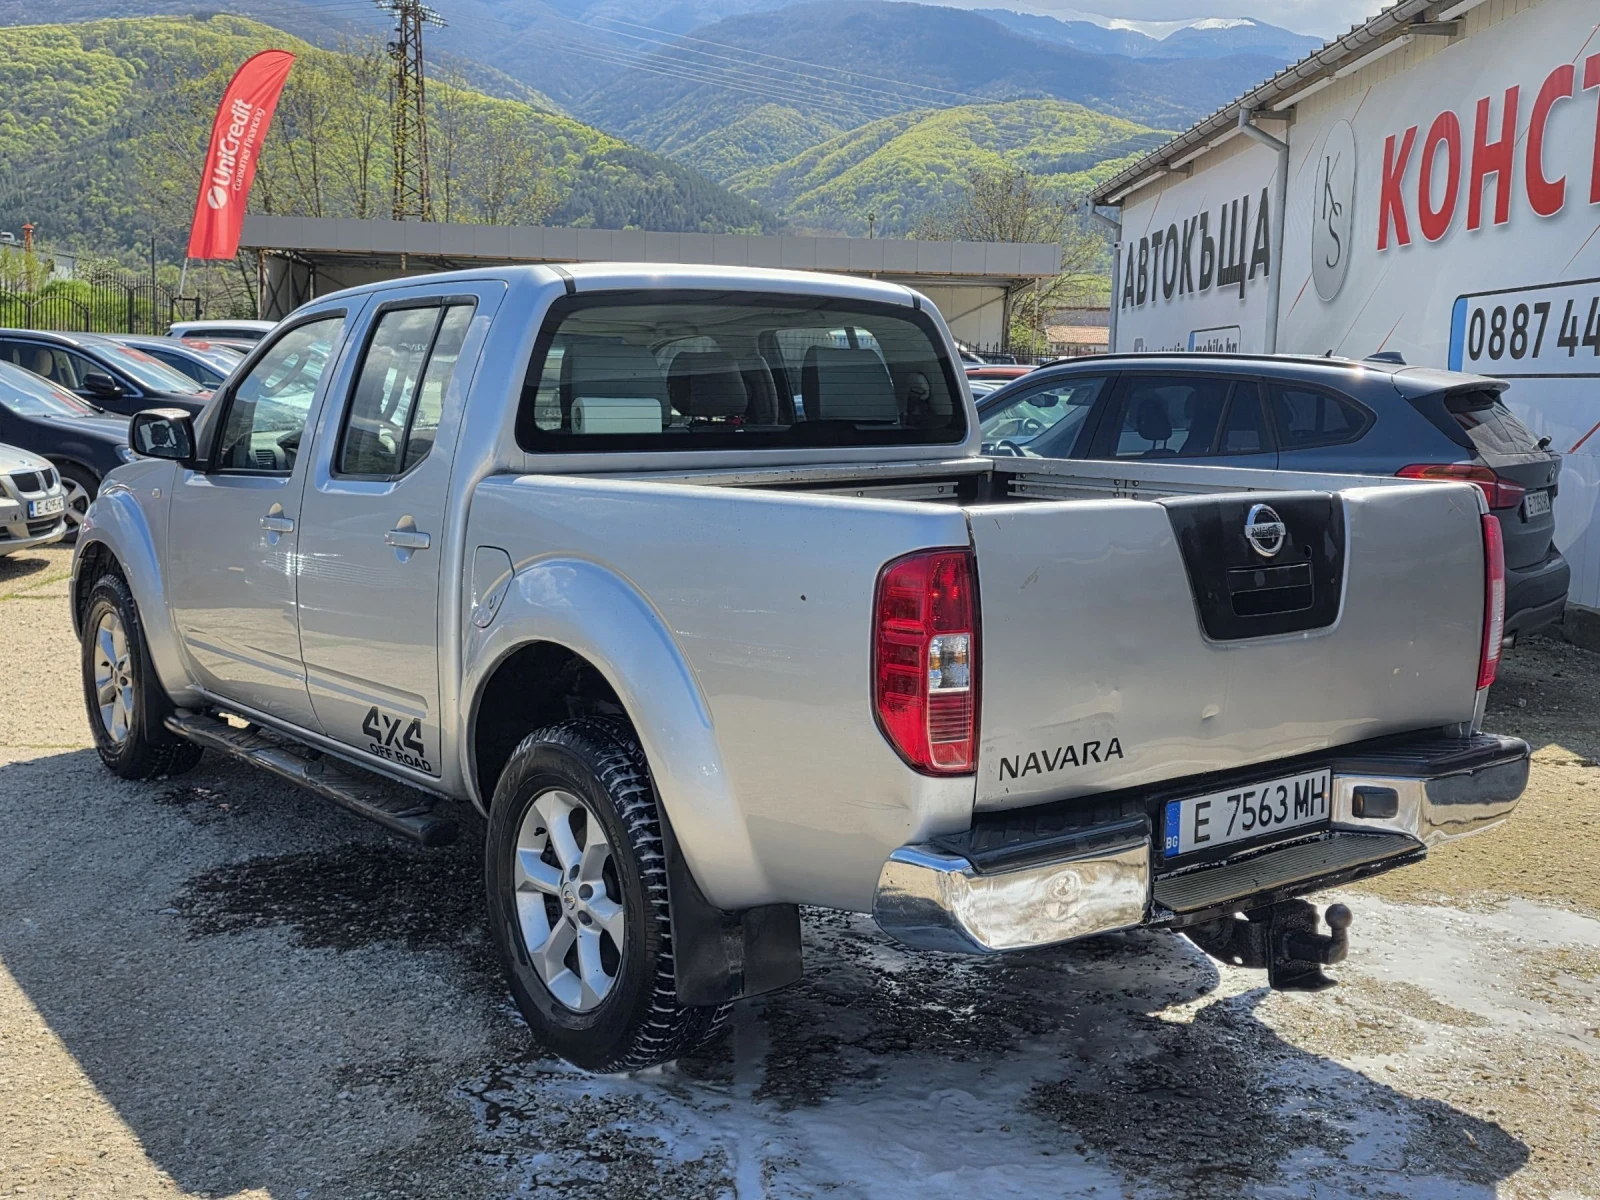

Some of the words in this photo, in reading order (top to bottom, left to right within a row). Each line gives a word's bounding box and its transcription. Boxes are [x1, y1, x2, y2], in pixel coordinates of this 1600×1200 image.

[213, 98, 252, 186] UniCredit
[233, 148, 251, 191] Consumer
[244, 107, 266, 149] Financing
[1121, 187, 1270, 309] АВТОКЪЩА
[1468, 303, 1551, 361] 0887
[1557, 297, 1600, 357] 44
[370, 743, 392, 758] OFF
[395, 751, 432, 772] ROAD
[999, 738, 1124, 781] NAVARA
[1166, 836, 1178, 849] BG
[1194, 801, 1211, 844] E
